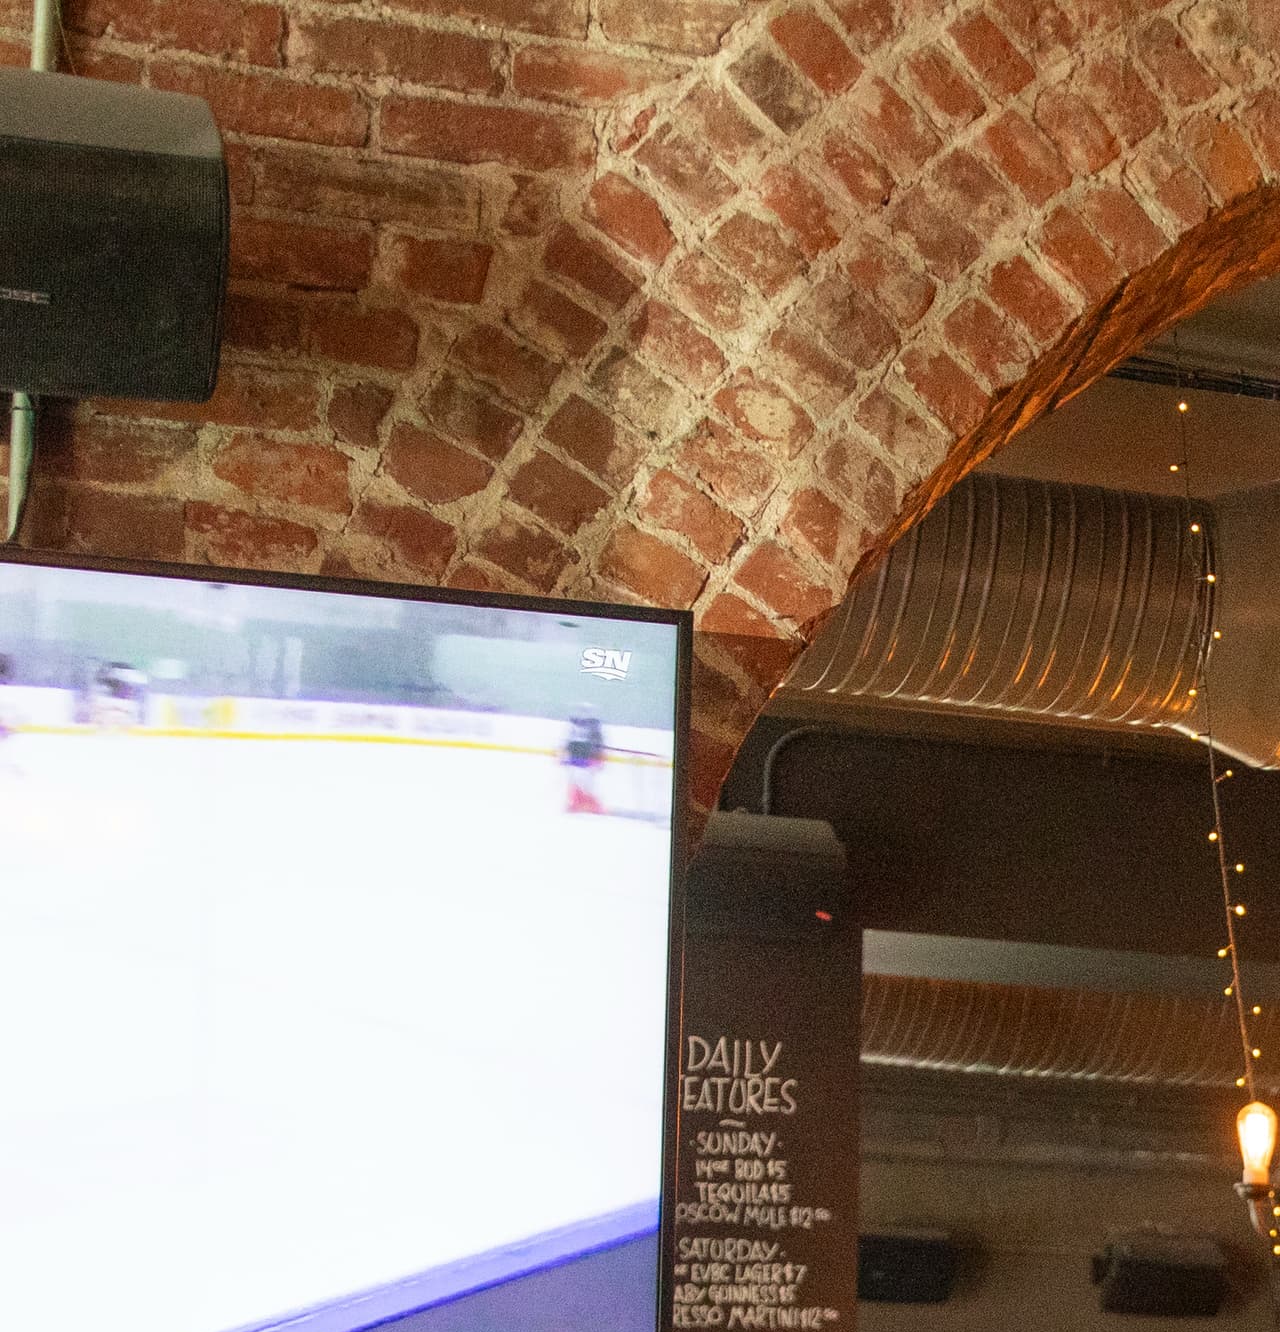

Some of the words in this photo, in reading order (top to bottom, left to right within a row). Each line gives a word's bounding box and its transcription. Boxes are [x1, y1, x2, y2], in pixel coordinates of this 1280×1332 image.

[581, 647, 633, 673] SN
[687, 1035, 783, 1078] DAILY
[680, 1074, 798, 1115] EATURES
[696, 1131, 777, 1157] SUNDAY
[675, 1202, 741, 1224] OSCOW
[678, 1236, 781, 1263] SATURDAY
[673, 1284, 707, 1304] ABY
